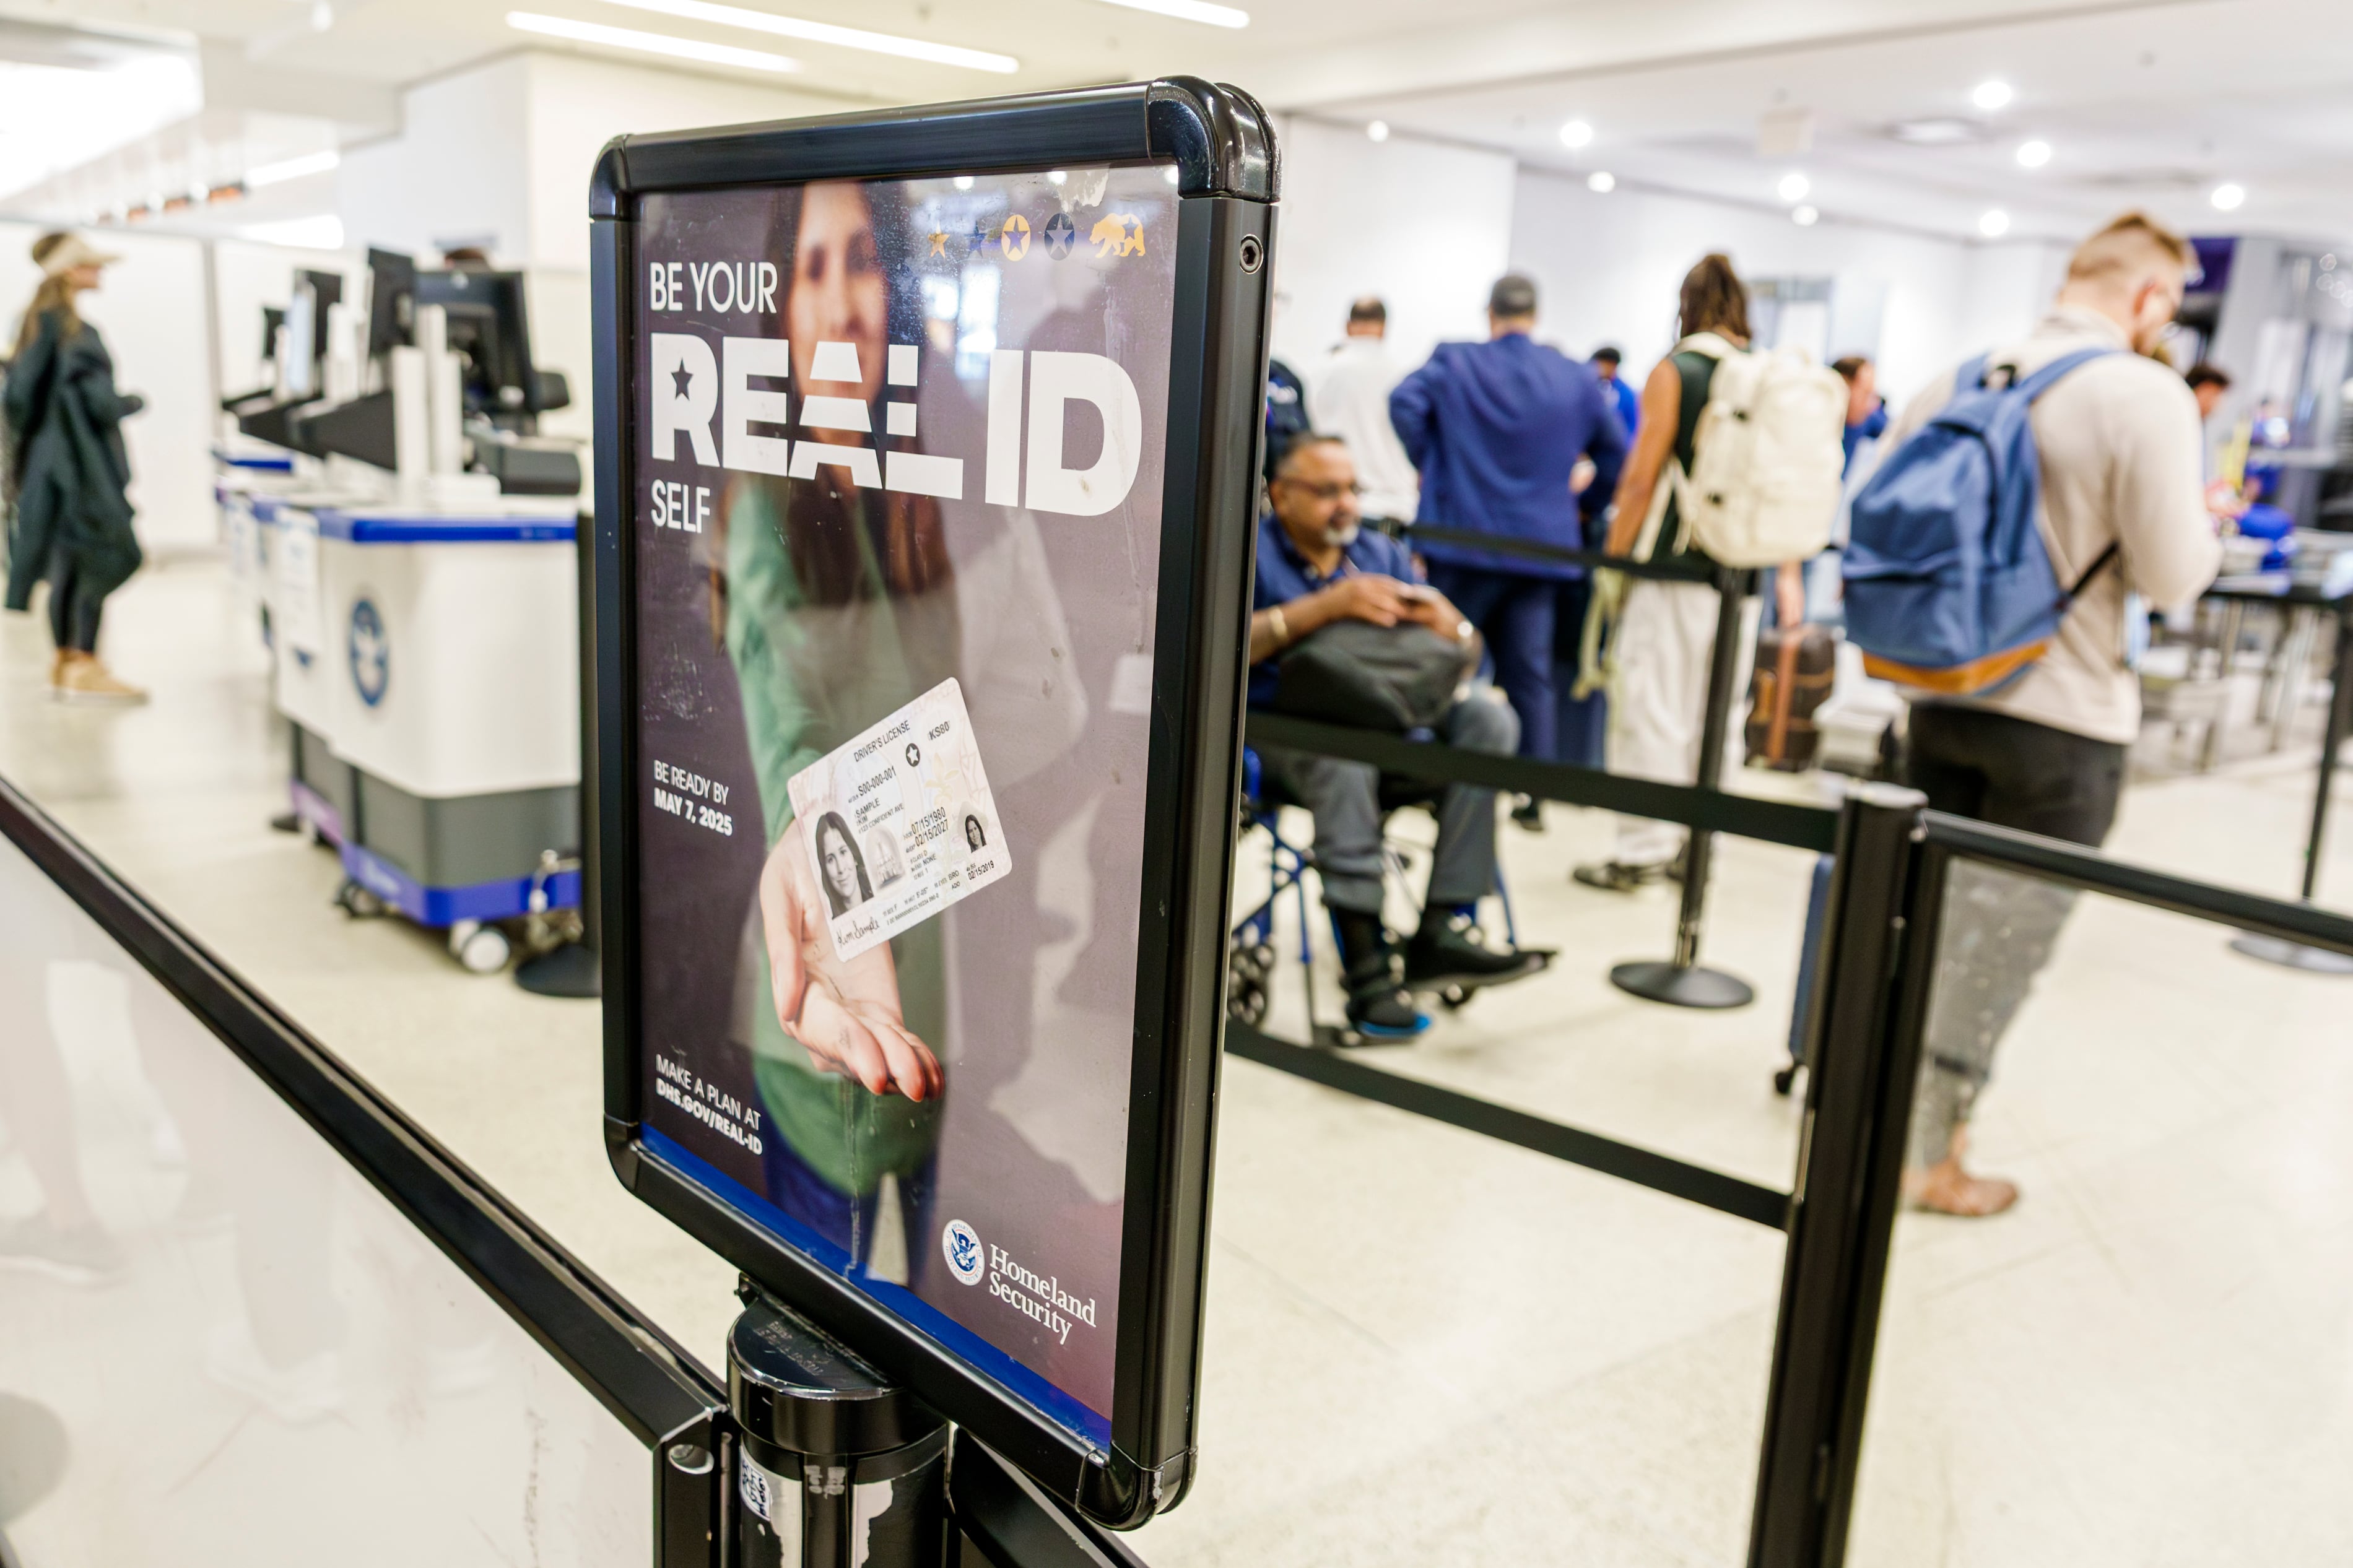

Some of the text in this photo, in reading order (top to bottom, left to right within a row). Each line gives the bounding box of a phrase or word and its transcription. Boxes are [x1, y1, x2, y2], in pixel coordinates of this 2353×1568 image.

[651, 261, 777, 313] BE YOUR
[651, 332, 1142, 517] REAL ID
[651, 479, 710, 534] SELF
[854, 720, 910, 762] DRIVER'S LICENSE
[654, 760, 729, 805] BE READY BY
[858, 765, 896, 796] S00-000-001
[654, 787, 733, 836] MAY 7, 2025
[856, 798, 880, 818] SAMPLE
[858, 815, 868, 825] KIM
[894, 803, 904, 813] AVE
[911, 807, 946, 834] 07/15/1980
[915, 819, 949, 847] 02/15/2027
[923, 854, 937, 865] NONE
[948, 870, 959, 880] BRO
[968, 860, 994, 880] 02/15/2019
[656, 1054, 761, 1131] MAKE A PLAN AT
[656, 1078, 762, 1155] DHS.GOV/REAL-ID
[990, 1244, 1096, 1328] Homeland
[989, 1271, 1072, 1345] Security
